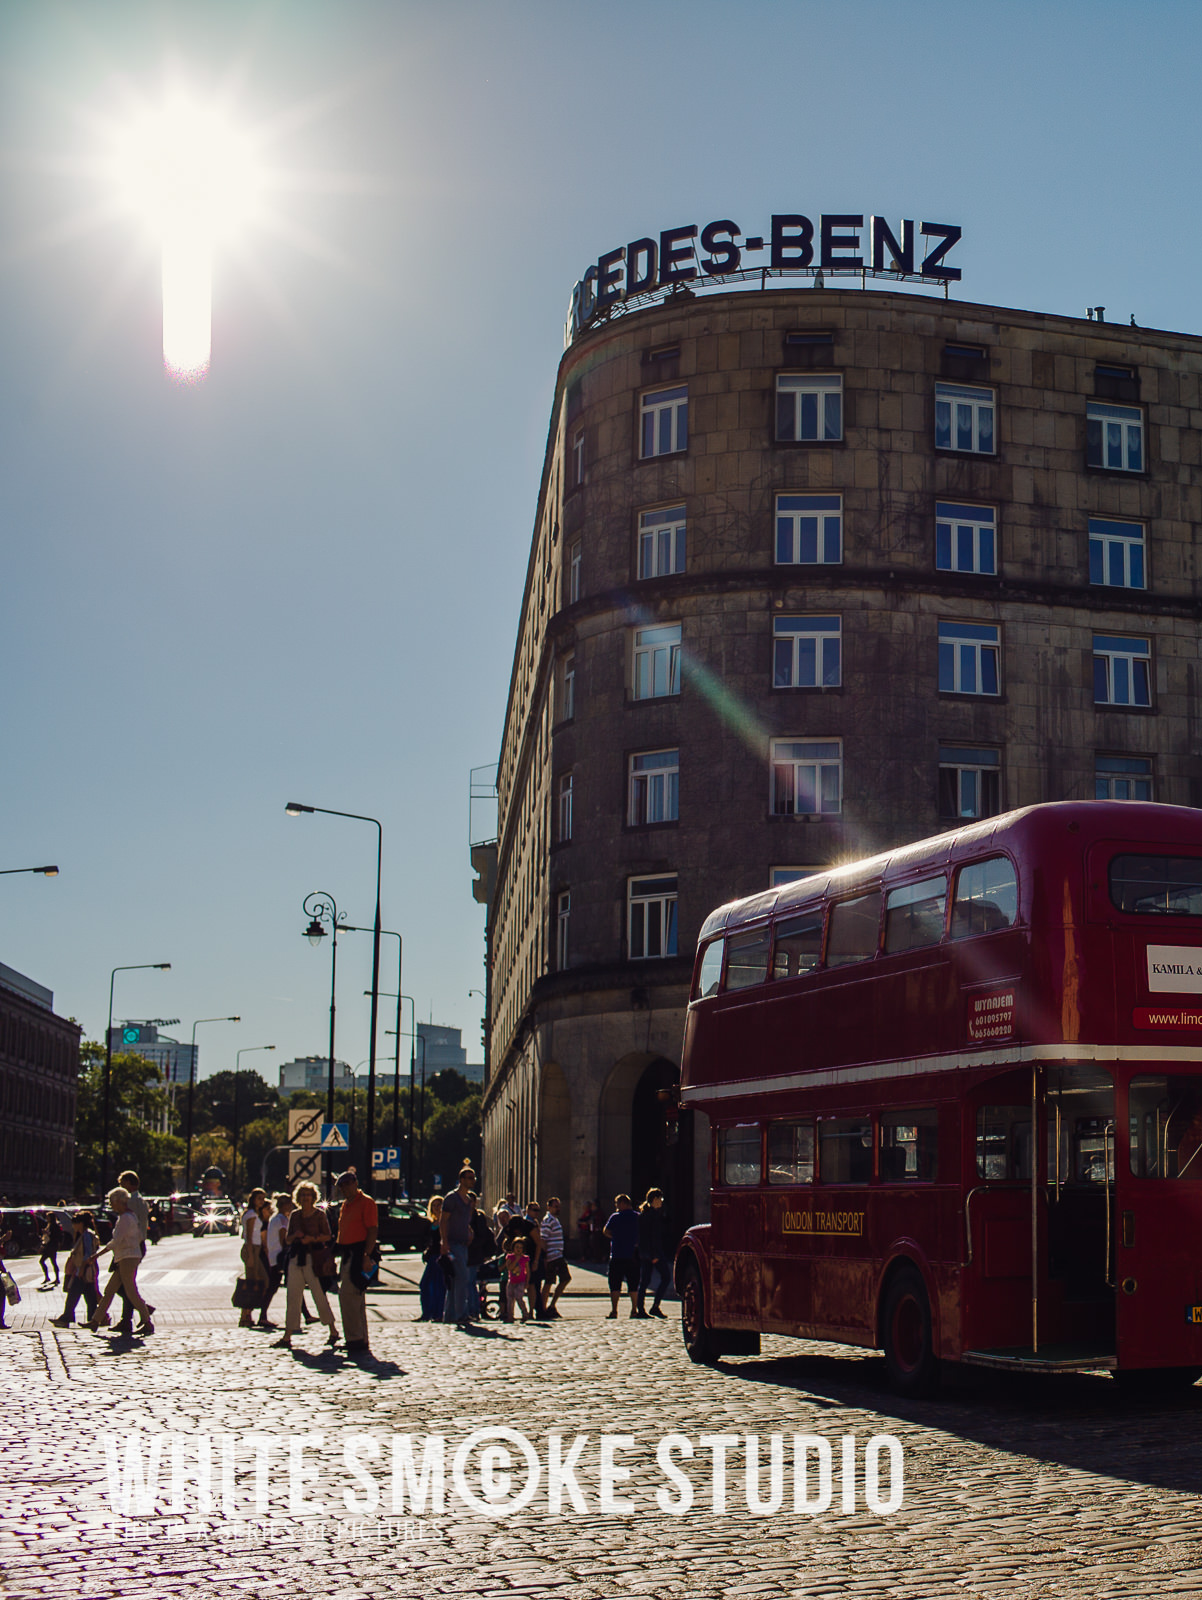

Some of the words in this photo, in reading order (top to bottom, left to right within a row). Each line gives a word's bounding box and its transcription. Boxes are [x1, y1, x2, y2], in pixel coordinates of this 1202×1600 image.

[1152, 963, 1194, 976] KAMILA
[975, 1011, 1012, 1025] 601095797
[372, 1151, 384, 1168] P
[387, 1149, 398, 1163] P
[782, 1211, 813, 1233] LONDON
[815, 1211, 865, 1236] TRANSPORT
